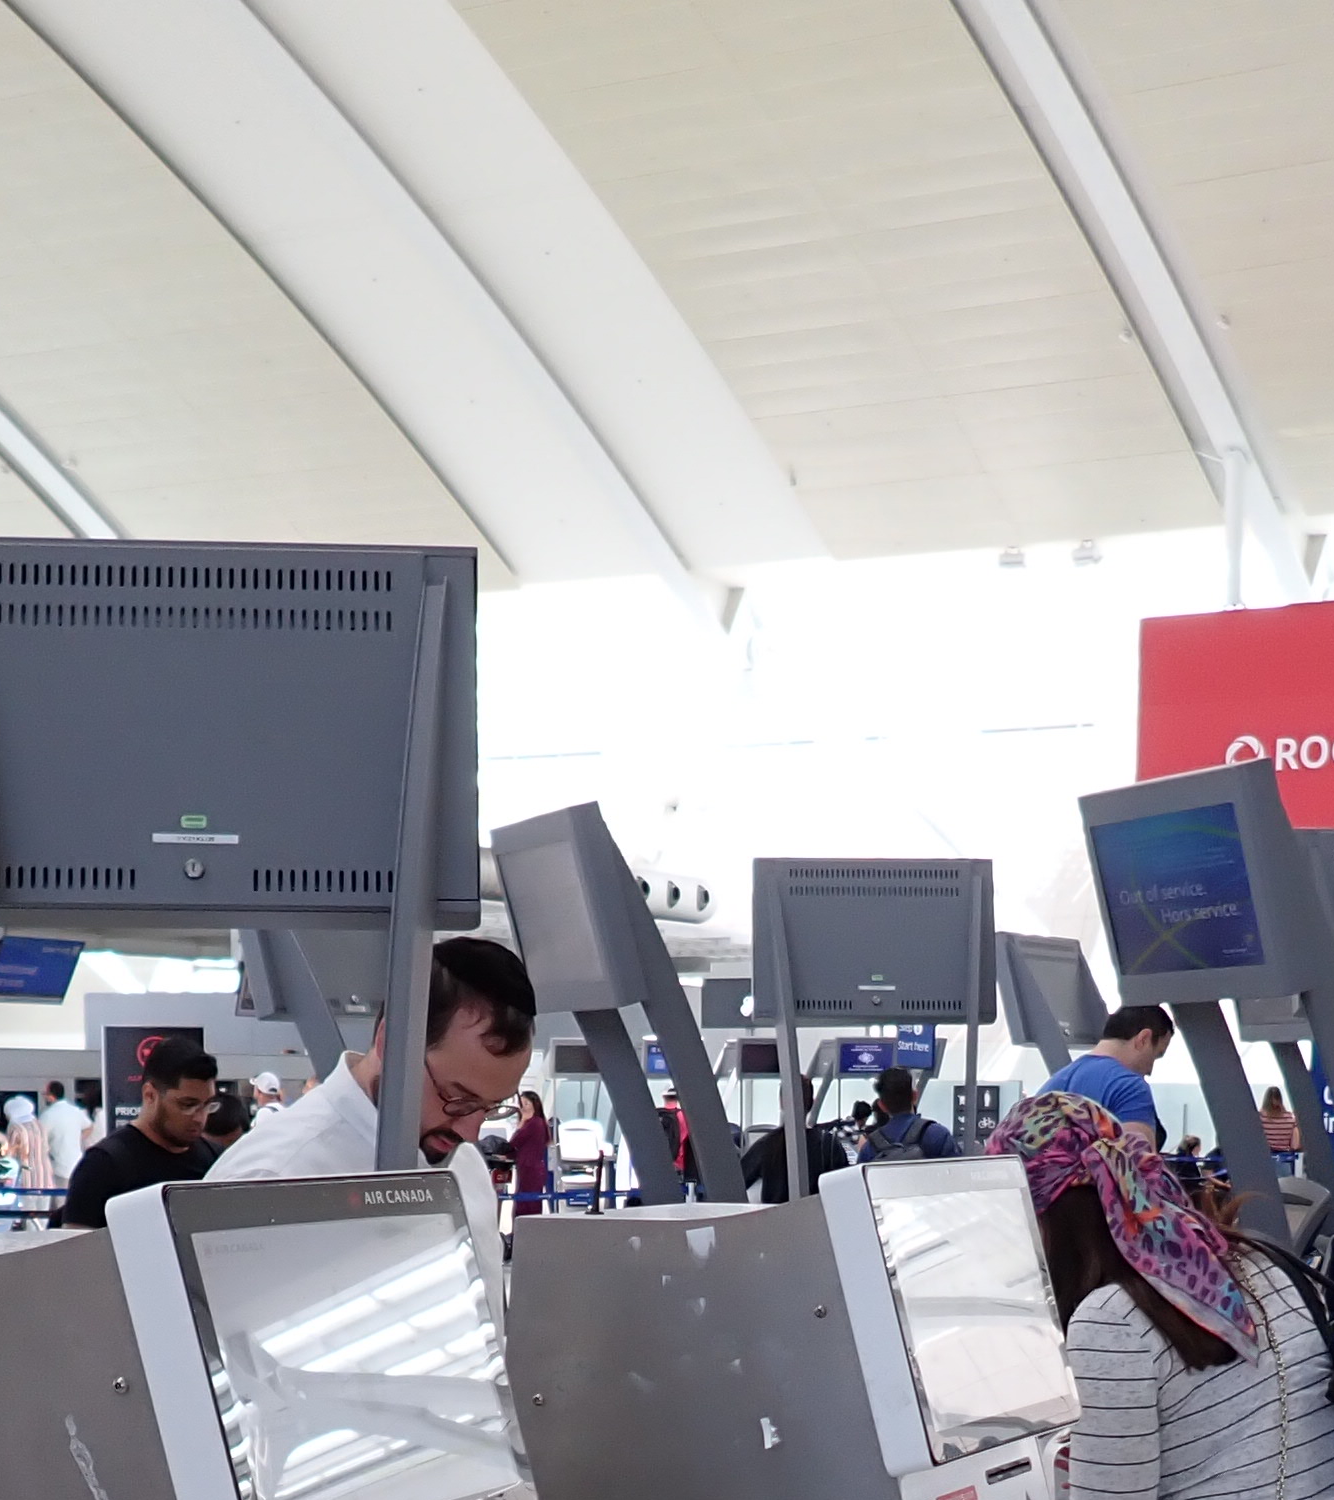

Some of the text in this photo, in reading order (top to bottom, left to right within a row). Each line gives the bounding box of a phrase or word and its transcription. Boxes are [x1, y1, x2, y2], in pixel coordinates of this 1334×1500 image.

[1119, 890, 1143, 905] Out
[1146, 884, 1158, 902] of
[898, 1041, 914, 1052] Start
[364, 1188, 433, 1205] AIR CANADA
